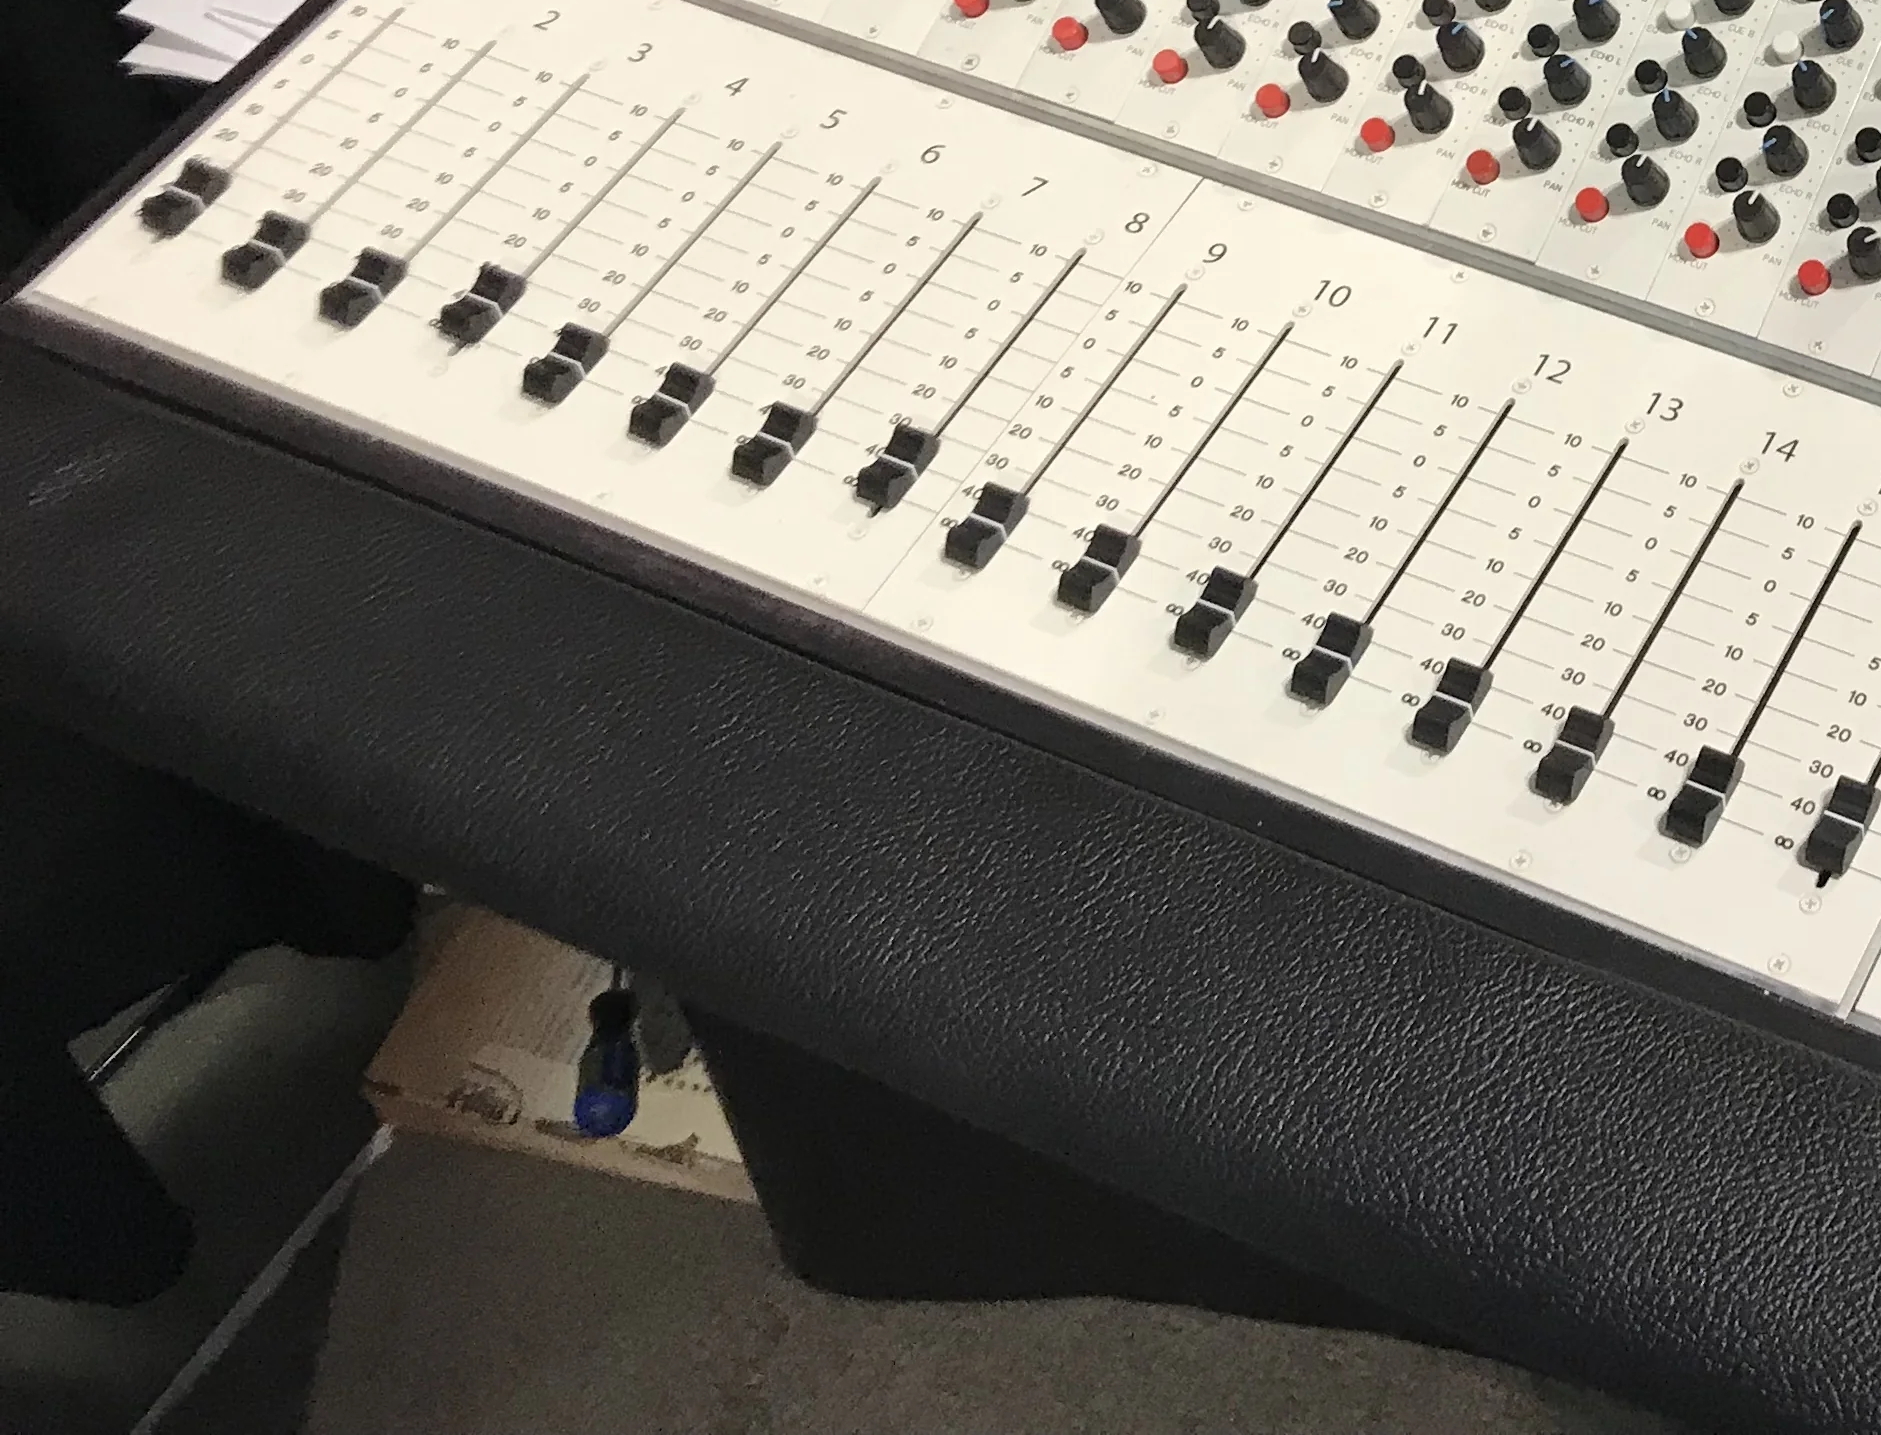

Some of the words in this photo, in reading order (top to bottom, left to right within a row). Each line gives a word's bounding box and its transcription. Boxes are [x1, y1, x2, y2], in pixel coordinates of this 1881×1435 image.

[533, 11, 560, 30] 2
[628, 43, 652, 62] 3
[725, 78, 749, 96] 4
[820, 109, 847, 129] 5
[921, 145, 945, 163] 6
[1022, 177, 1048, 196] 7
[1125, 213, 1150, 233] 8
[1203, 243, 1227, 263] 9
[1314, 280, 1351, 307] 10
[1423, 317, 1458, 344] 11
[1534, 354, 1571, 384] 12
[1647, 393, 1683, 421] 13
[1762, 432, 1799, 462] 14
